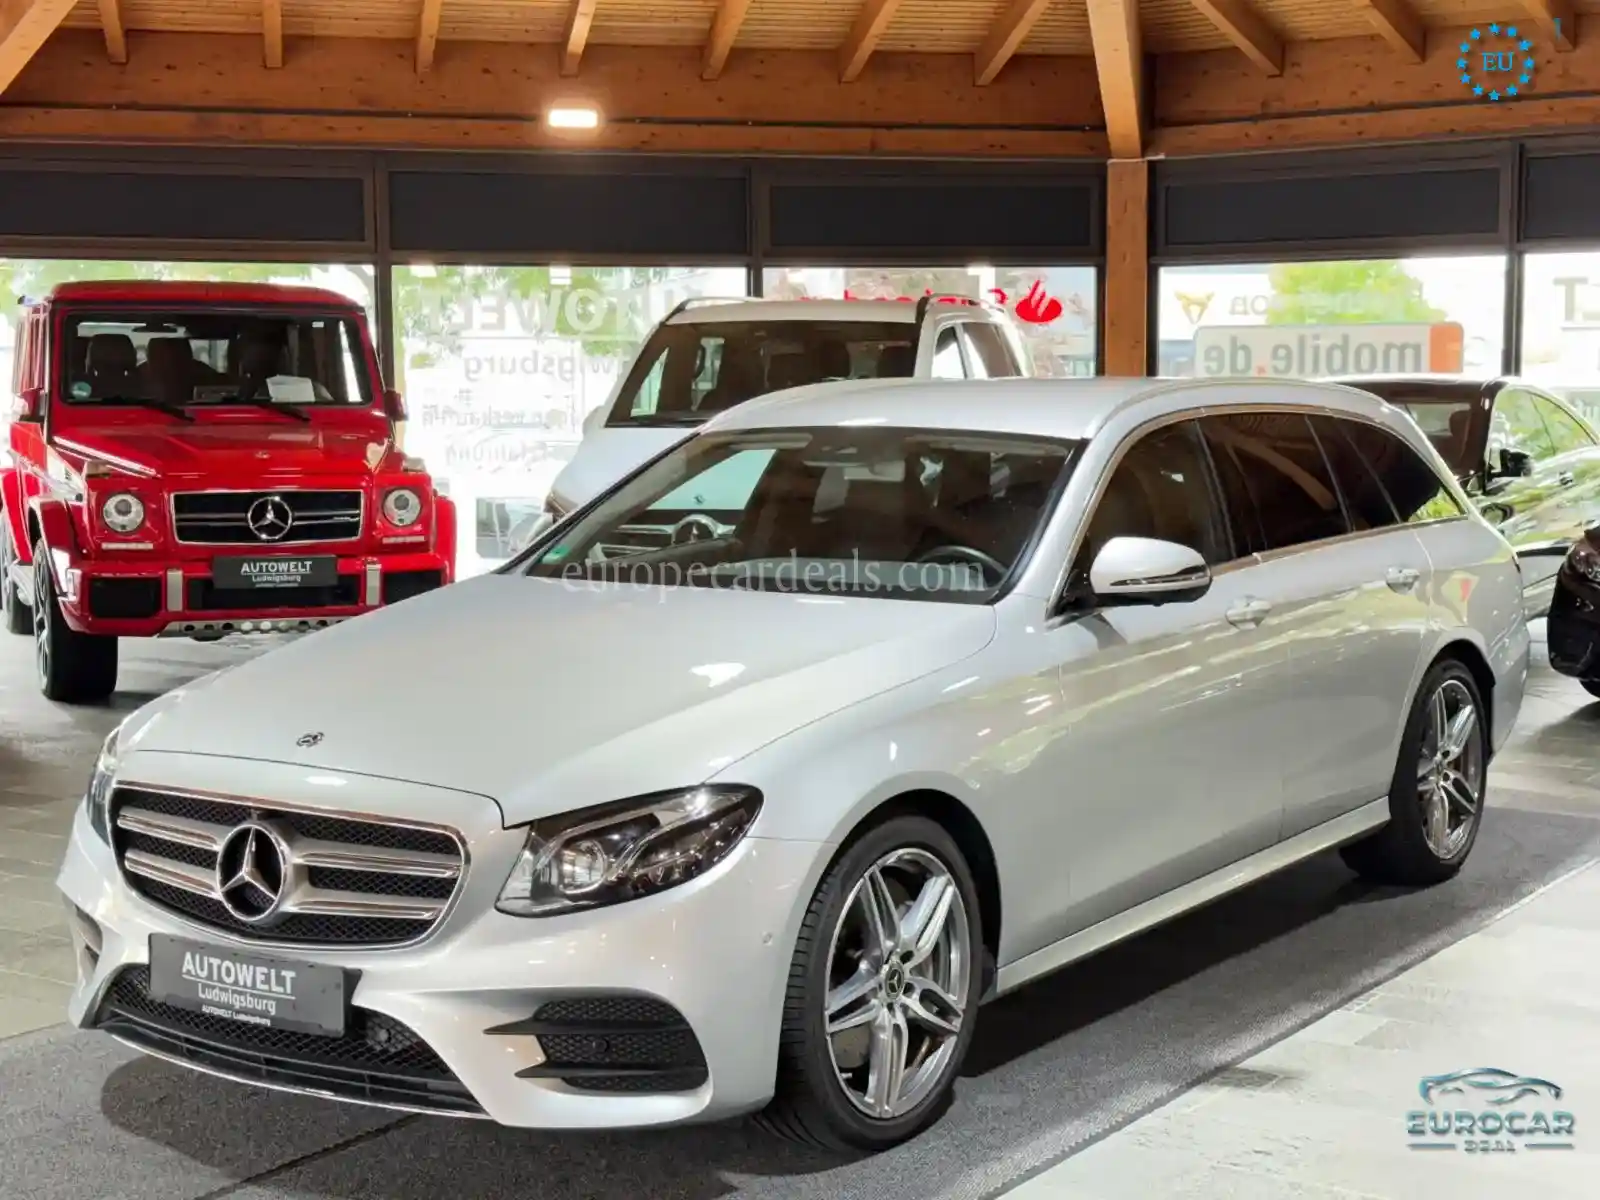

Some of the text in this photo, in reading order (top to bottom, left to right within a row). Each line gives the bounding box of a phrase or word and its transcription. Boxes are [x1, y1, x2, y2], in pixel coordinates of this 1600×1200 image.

[241, 561, 312, 574] AUTOWELT
[252, 574, 301, 583] Ludwigsburg
[182, 952, 297, 994] AUTOWELT
[198, 983, 276, 1015] Ludwigsburg
